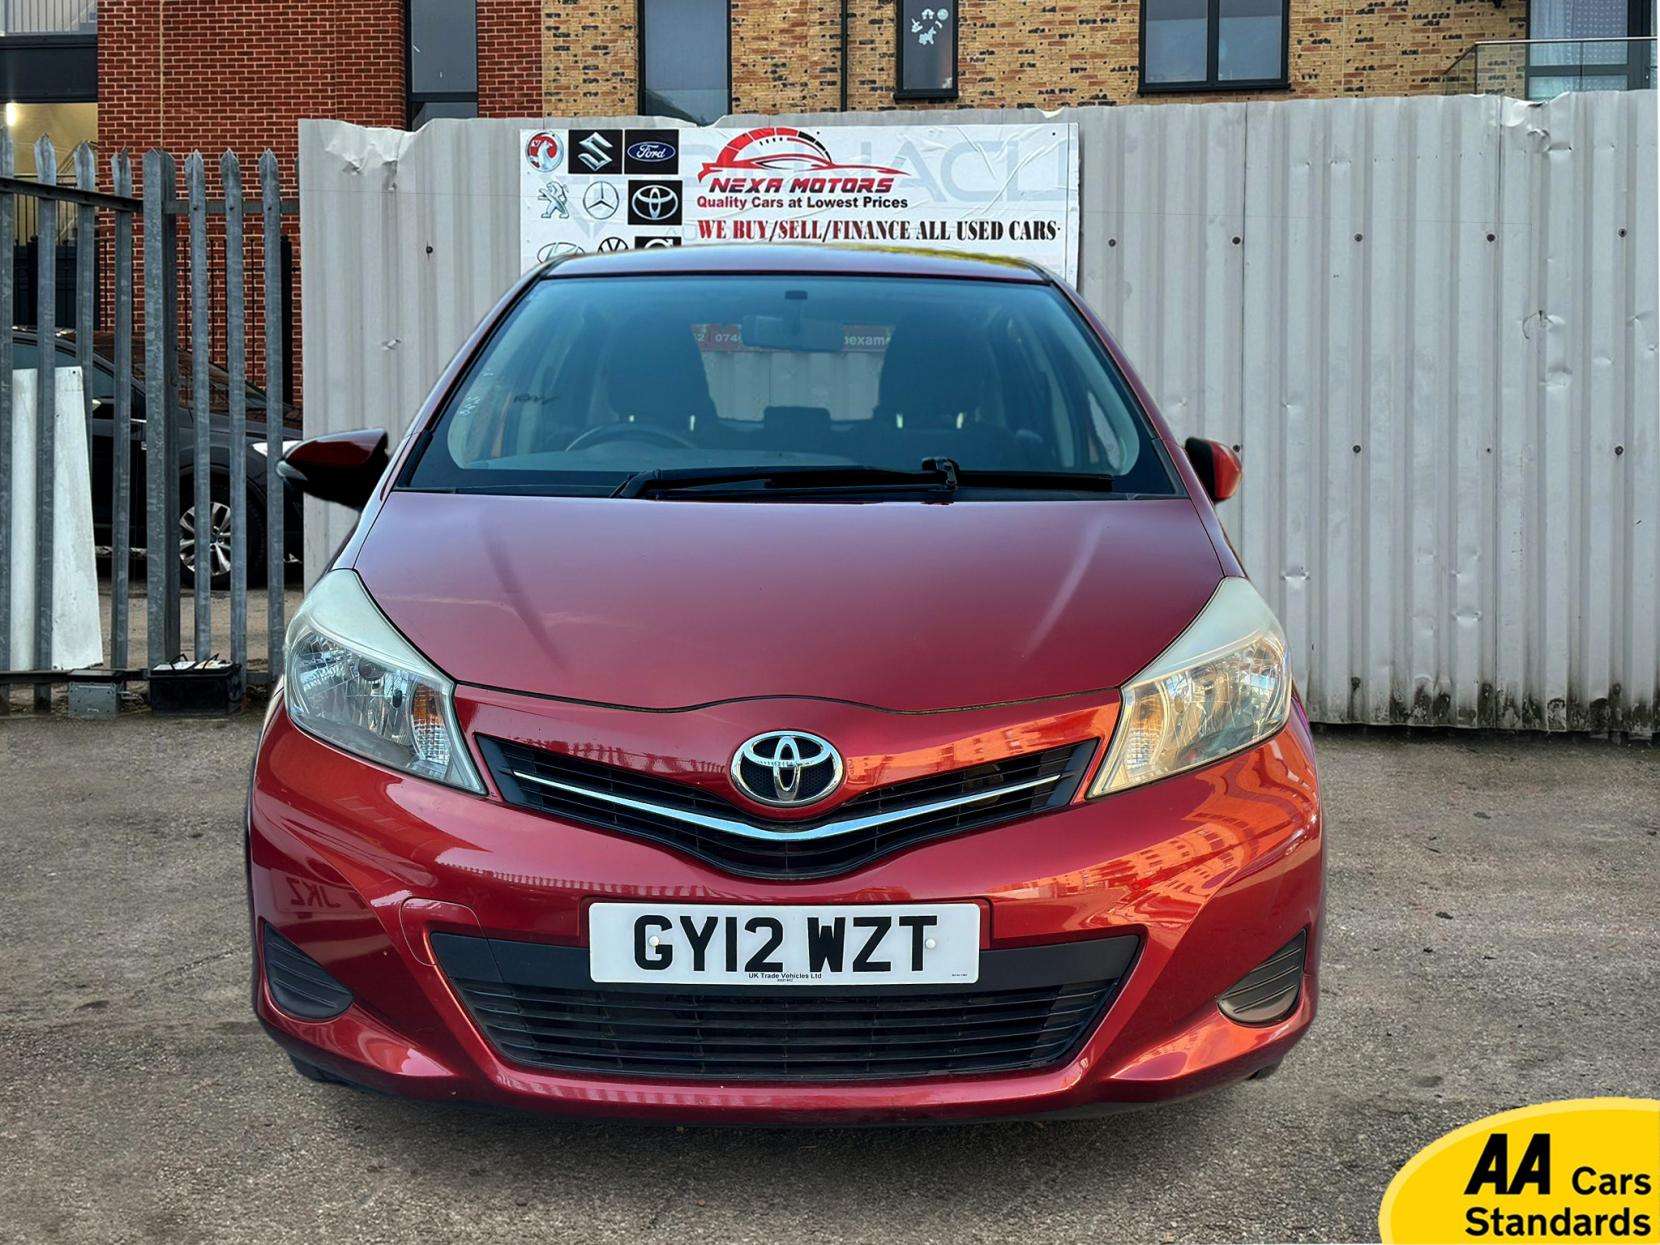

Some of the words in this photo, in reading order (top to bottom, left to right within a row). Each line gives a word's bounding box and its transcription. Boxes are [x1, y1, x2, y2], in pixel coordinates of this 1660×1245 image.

[636, 144, 667, 159] Ford
[709, 178, 784, 193] NEXA
[789, 178, 894, 193] MOTORS
[697, 196, 747, 210] Quality
[752, 196, 783, 208] Cars
[788, 197, 802, 208] at
[807, 196, 858, 208] Lowest
[863, 196, 908, 208] Prices
[697, 219, 727, 240] WE
[916, 220, 951, 240] ALL
[956, 220, 1004, 240] USED
[1008, 220, 1057, 240] CARS
[634, 914, 784, 972] GY12
[807, 915, 938, 973] WZT
